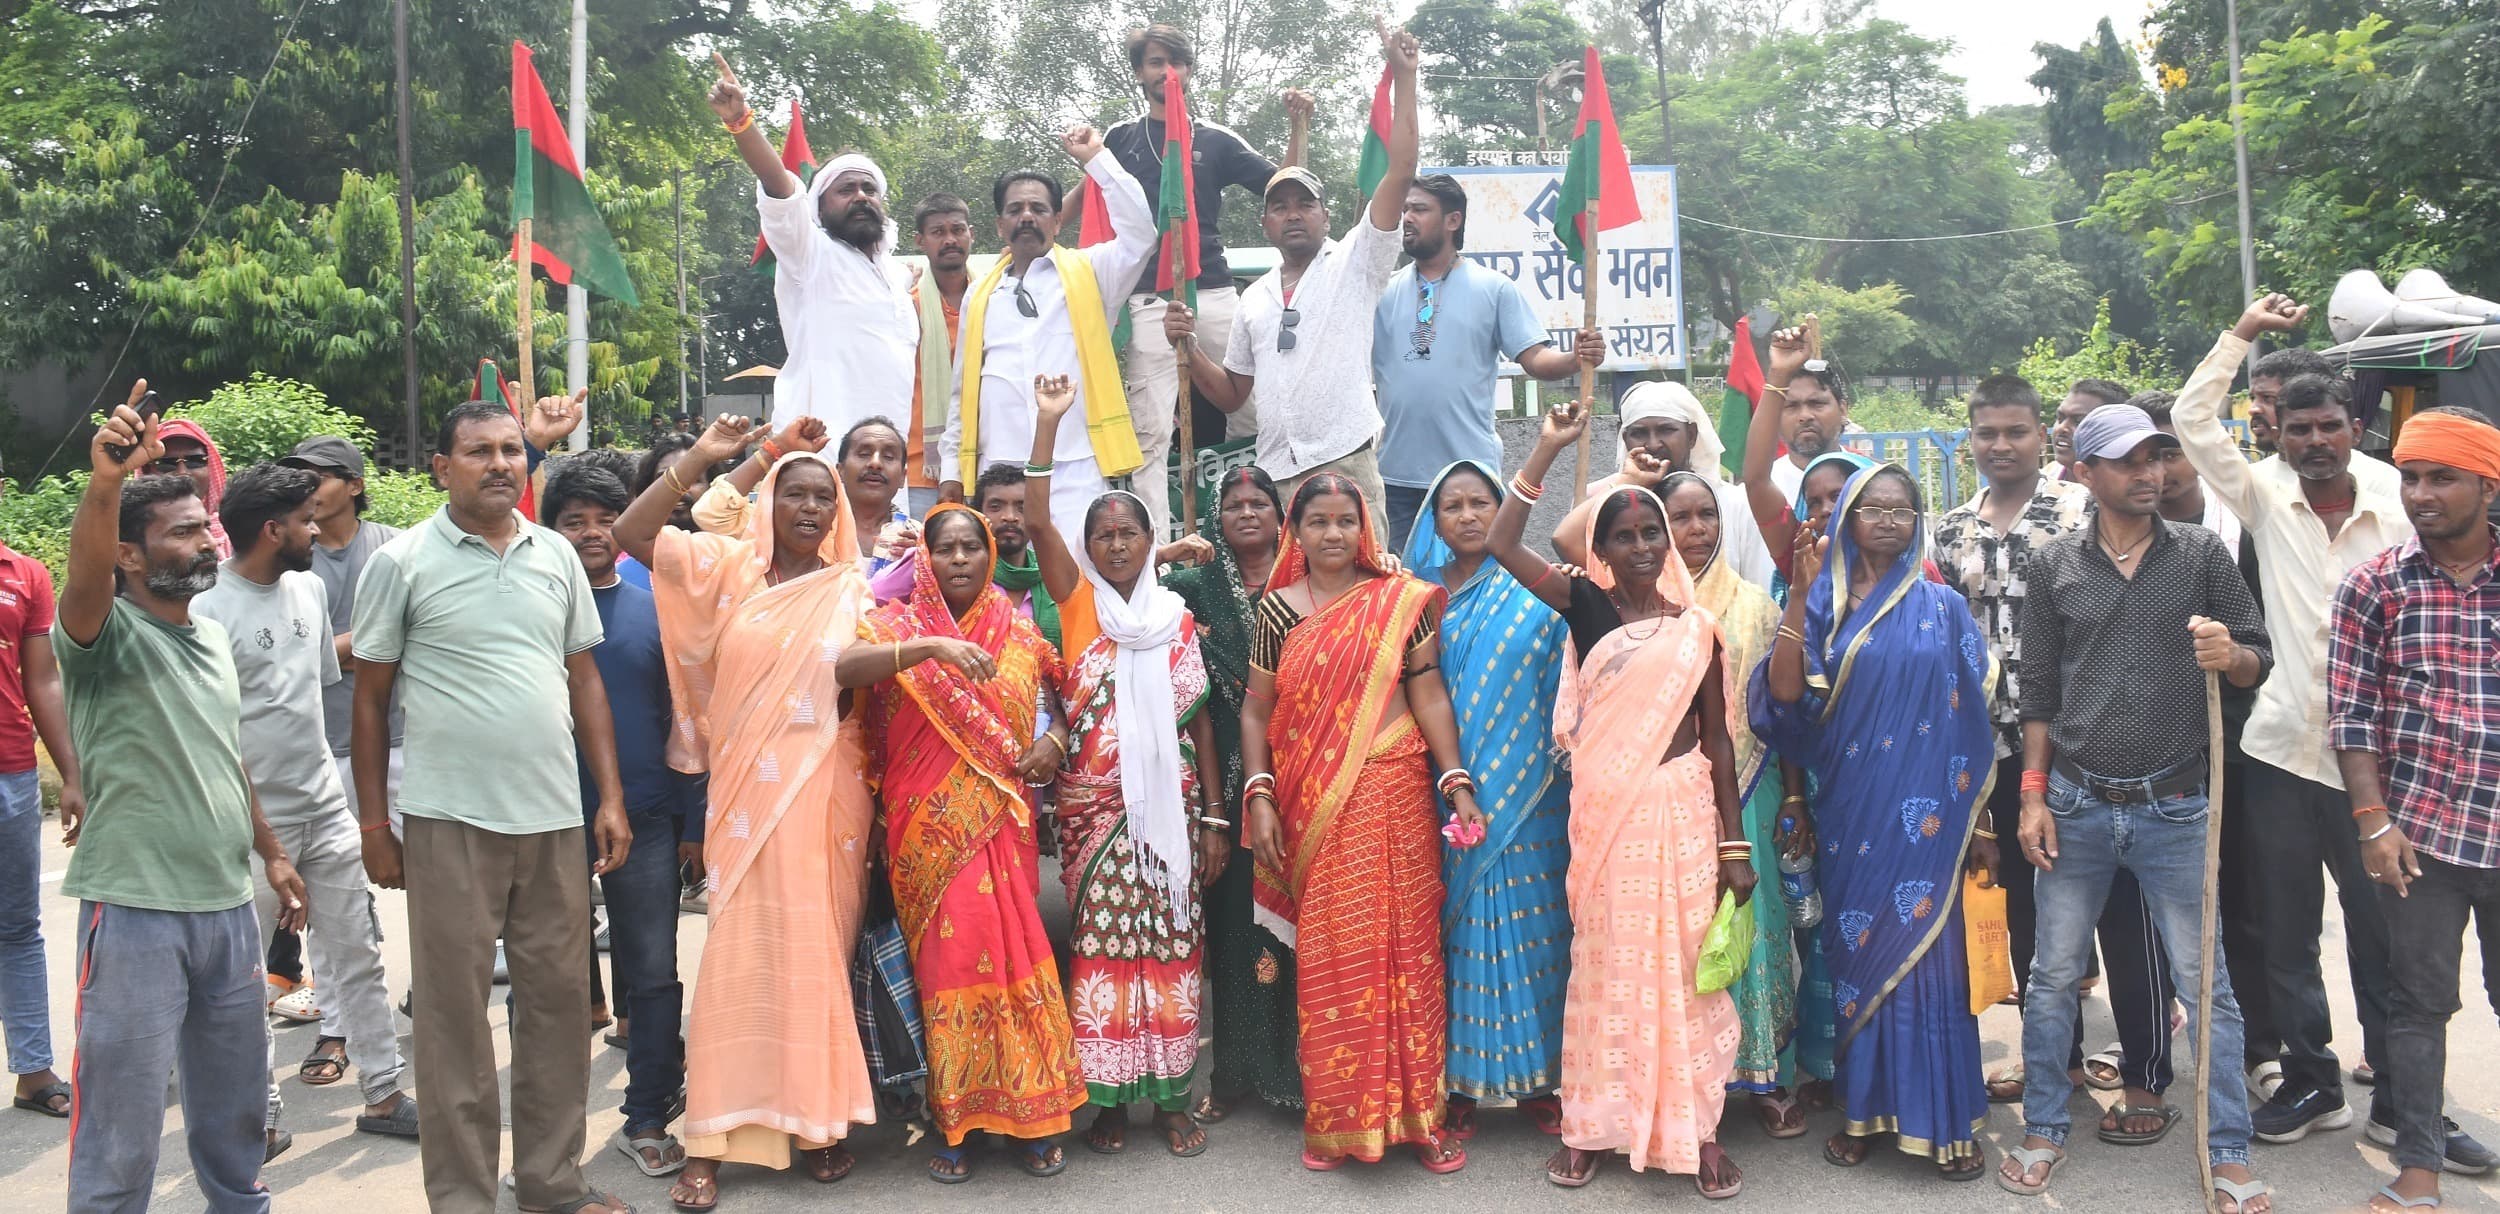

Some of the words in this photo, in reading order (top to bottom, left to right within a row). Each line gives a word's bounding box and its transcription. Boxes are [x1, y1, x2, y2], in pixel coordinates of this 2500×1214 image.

[1515, 151, 1537, 166] का
[1533, 241, 1600, 300] सेव
[1608, 247, 1673, 299] भवन
